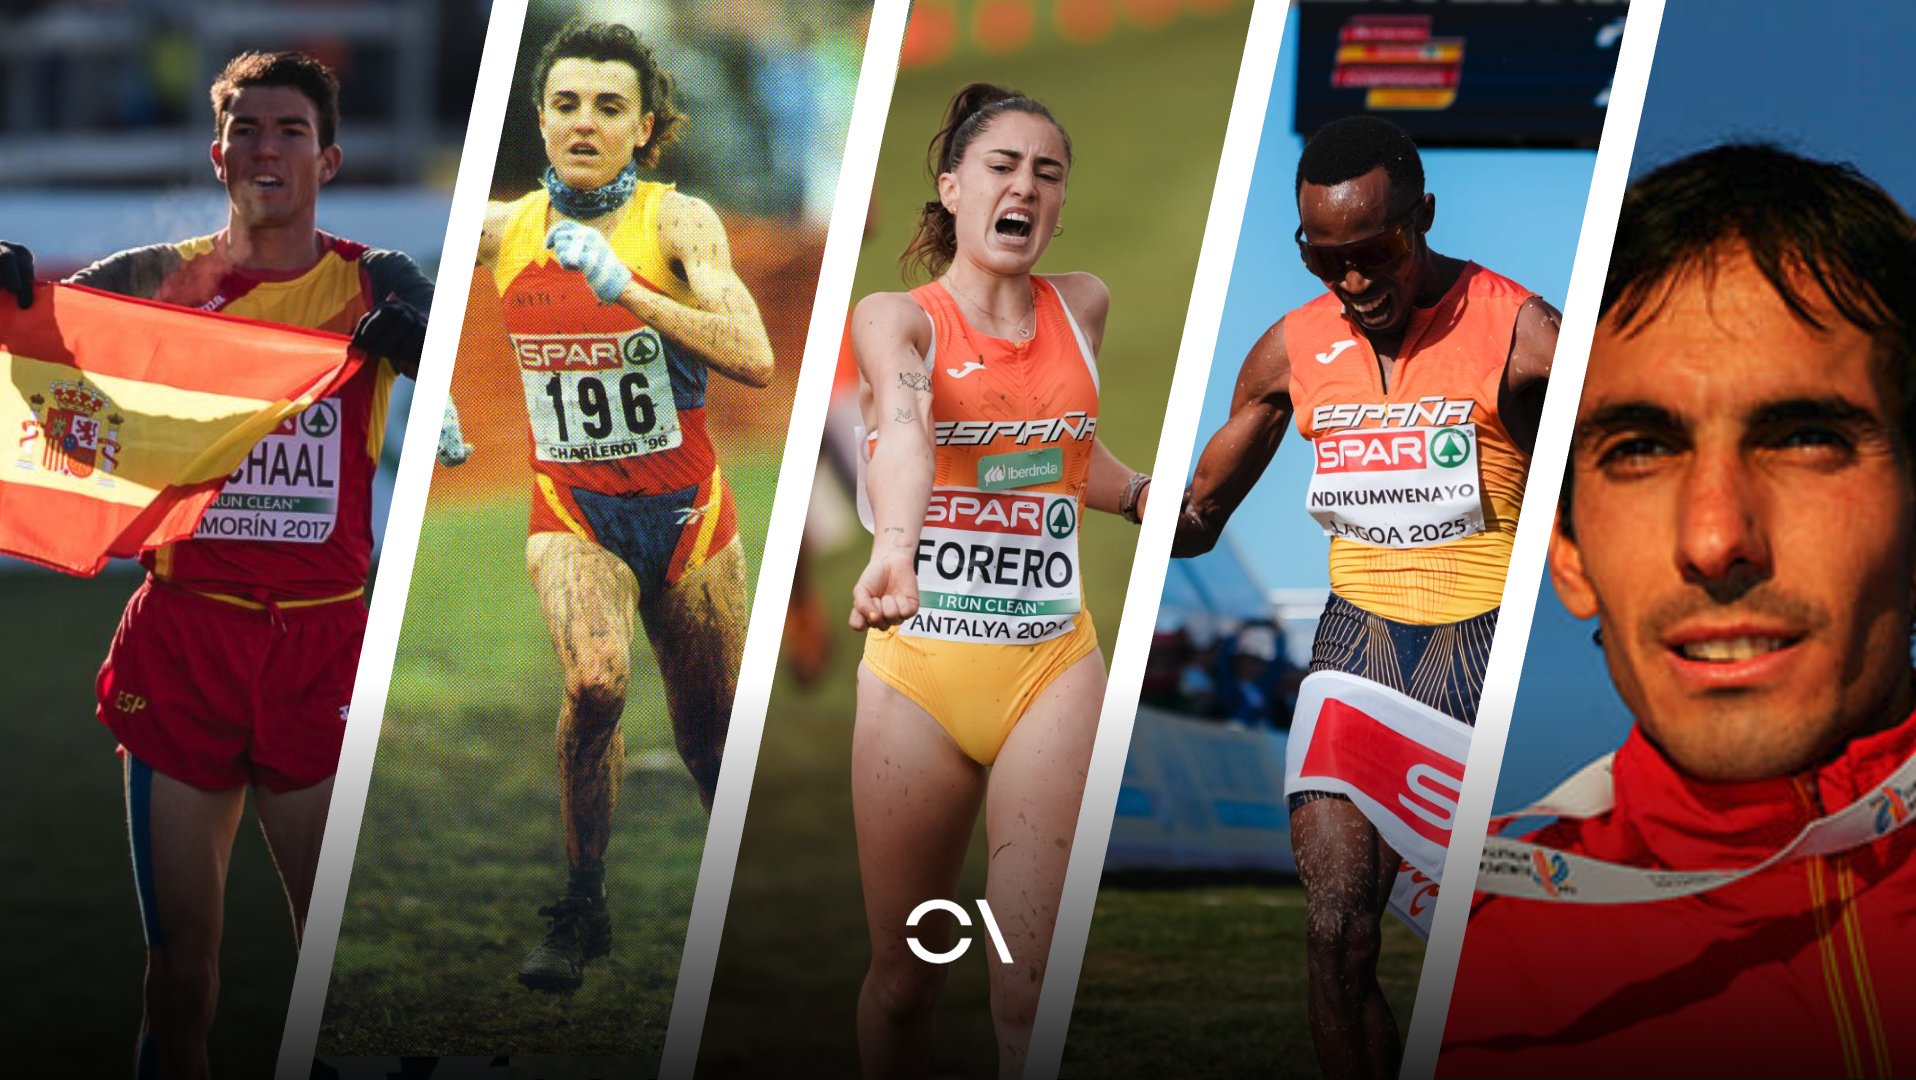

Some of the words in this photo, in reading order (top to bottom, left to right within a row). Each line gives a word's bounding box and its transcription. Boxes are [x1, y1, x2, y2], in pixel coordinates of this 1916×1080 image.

[520, 342, 620, 366] SPAR
[546, 372, 657, 442] 196
[1312, 396, 1476, 431] ESPAÑA
[935, 411, 1097, 446] ESPAÑA
[550, 441, 638, 460] CHARLEROI
[645, 434, 668, 450] '96
[1319, 437, 1422, 469] SPAR
[1008, 462, 1058, 480] Iberdrola
[1311, 483, 1475, 507] NDIKUMWENAYO
[194, 512, 277, 537] MORÍN
[283, 519, 330, 540] 2017
[925, 496, 1040, 530] SPAR
[1330, 520, 1404, 544] LAGOA
[1409, 518, 1467, 543] 2025
[914, 539, 1073, 588] FORERO
[939, 595, 944, 607] I
[946, 596, 981, 611] RUN
[909, 613, 1011, 639] ANTALYA
[116, 690, 147, 713] ESP
